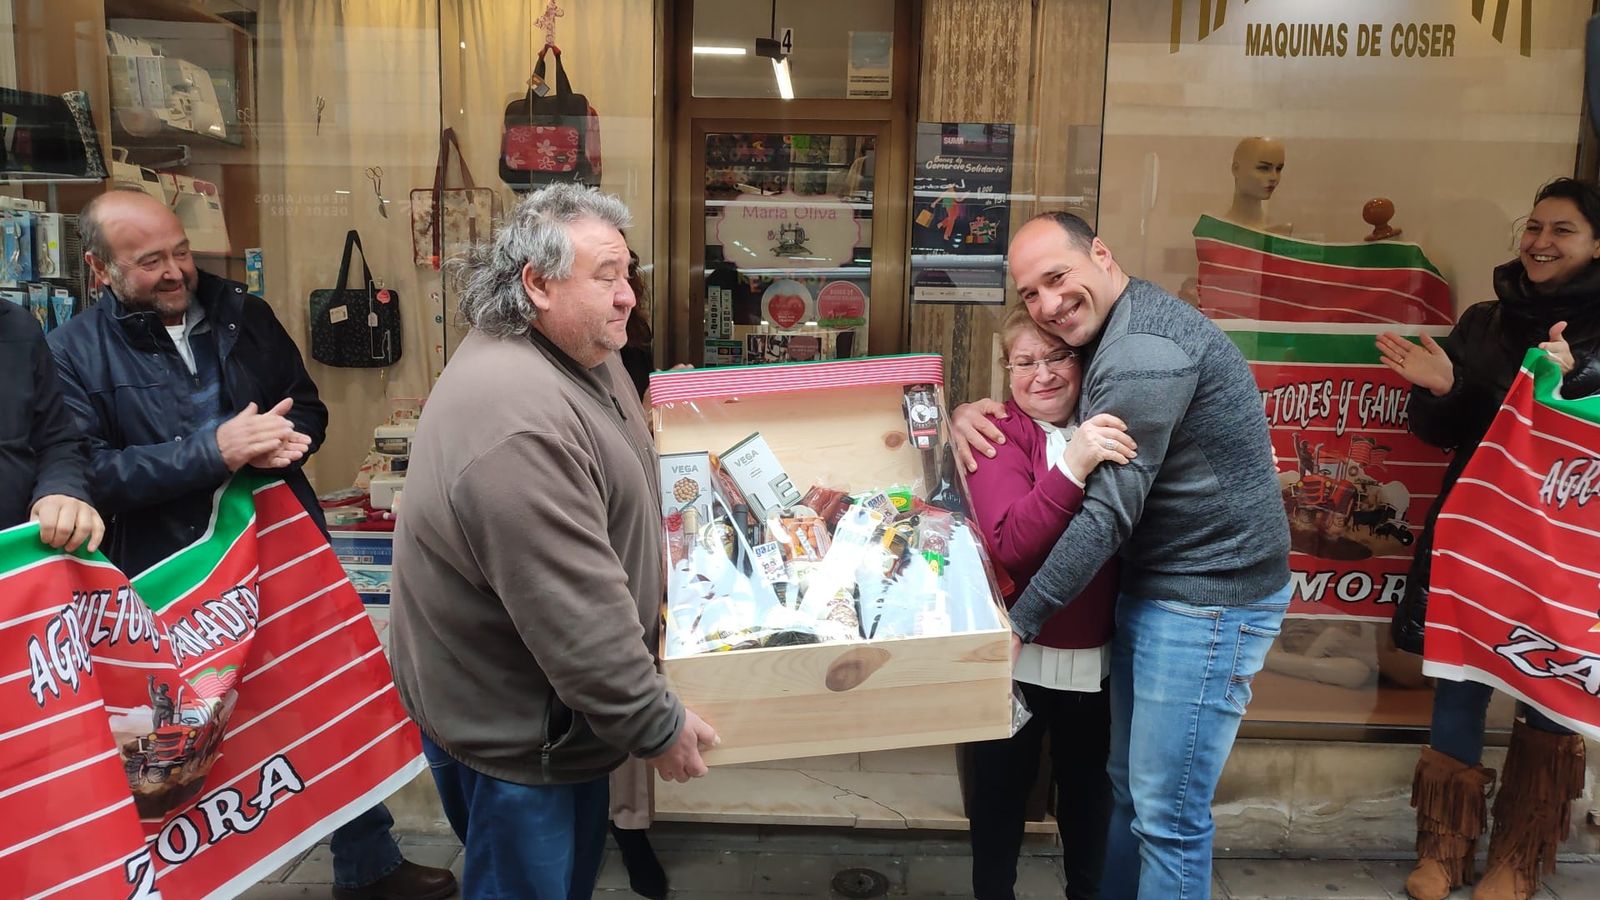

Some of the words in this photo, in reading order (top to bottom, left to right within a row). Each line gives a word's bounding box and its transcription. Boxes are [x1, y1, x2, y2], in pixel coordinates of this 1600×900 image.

[782, 29, 793, 53] 4
[1245, 23, 1348, 58] MAQUINAS
[1356, 24, 1383, 57] DE
[1390, 23, 1456, 58] COSER
[925, 160, 965, 170] Comercio
[964, 164, 1004, 173] Solidario
[734, 449, 759, 468] VEGA
[672, 465, 699, 474] VEGA
[1539, 456, 1600, 510] AGR
[755, 542, 778, 558] gaza
